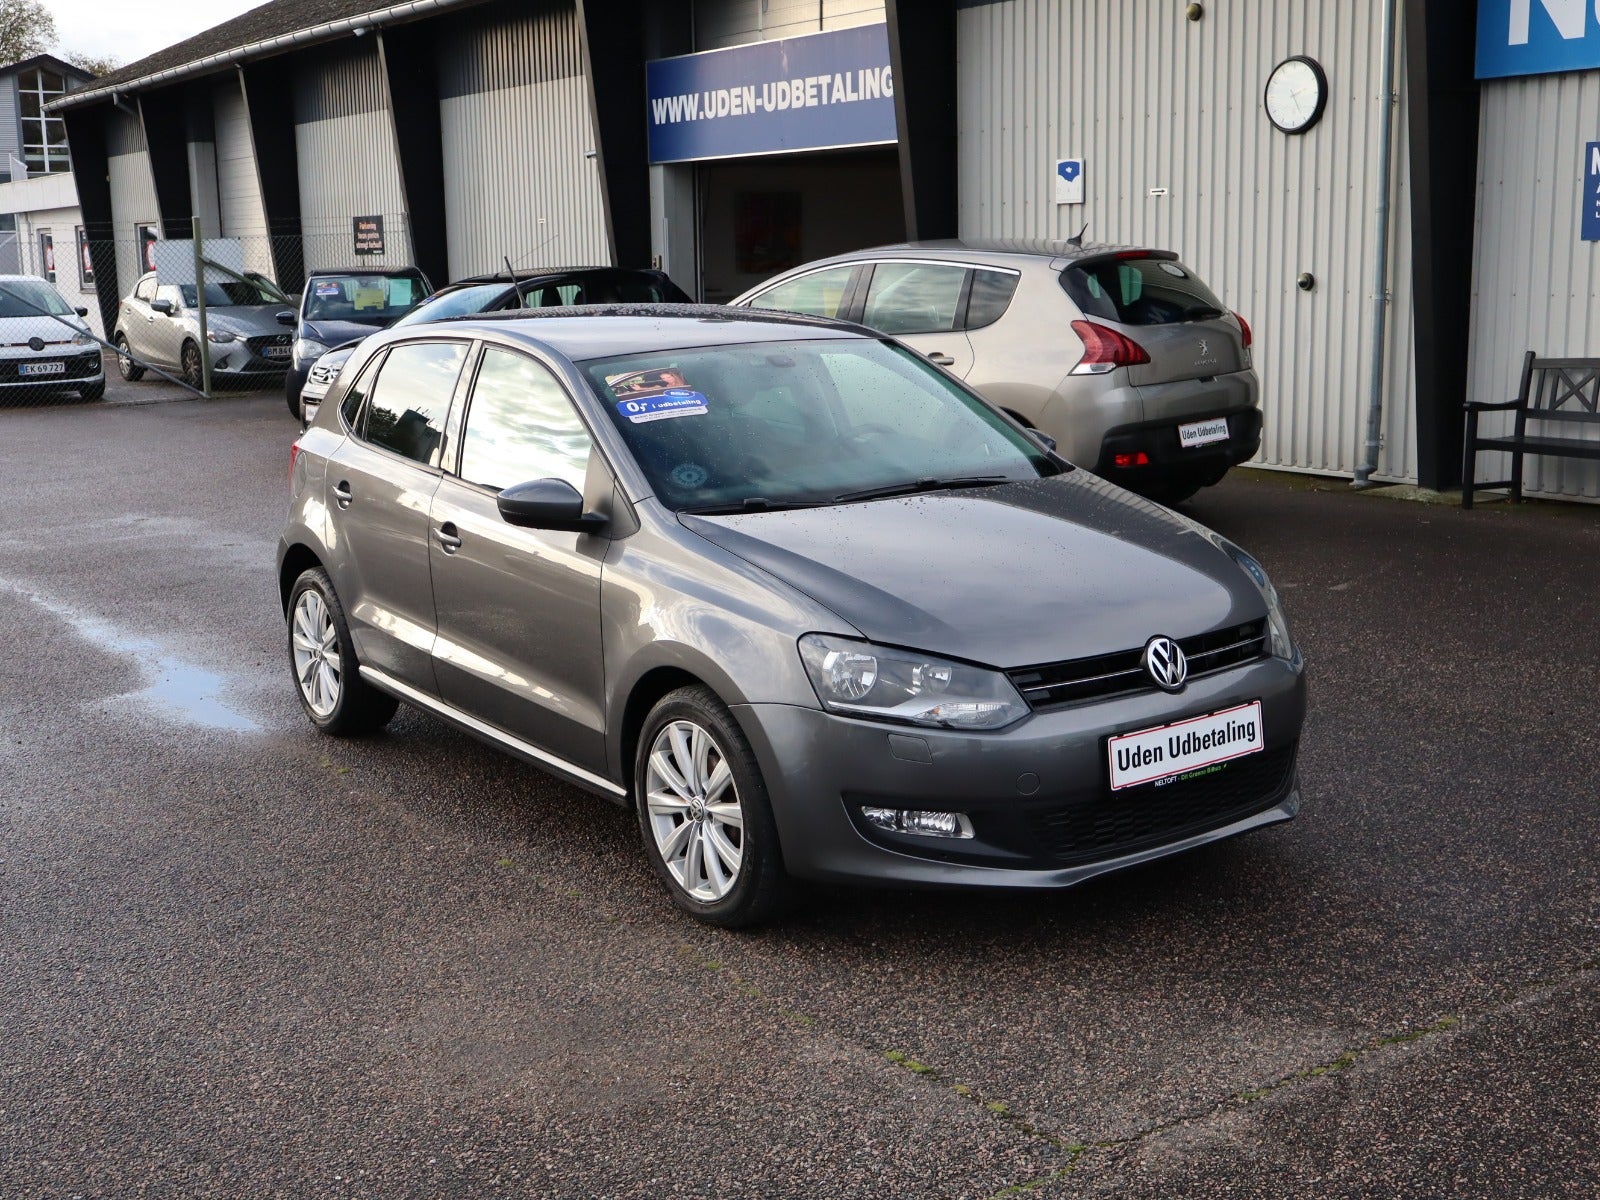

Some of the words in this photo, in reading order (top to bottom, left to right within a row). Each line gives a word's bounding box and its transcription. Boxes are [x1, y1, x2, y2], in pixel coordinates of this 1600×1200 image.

[25, 365, 36, 374] EK
[37, 365, 48, 373] 69
[1182, 430, 1197, 440] Uden
[1198, 424, 1226, 437] Udbetaling
[1117, 745, 1163, 771] Uden
[1168, 720, 1256, 758] Udbetaling
[1154, 776, 1178, 787] NELTOFT
